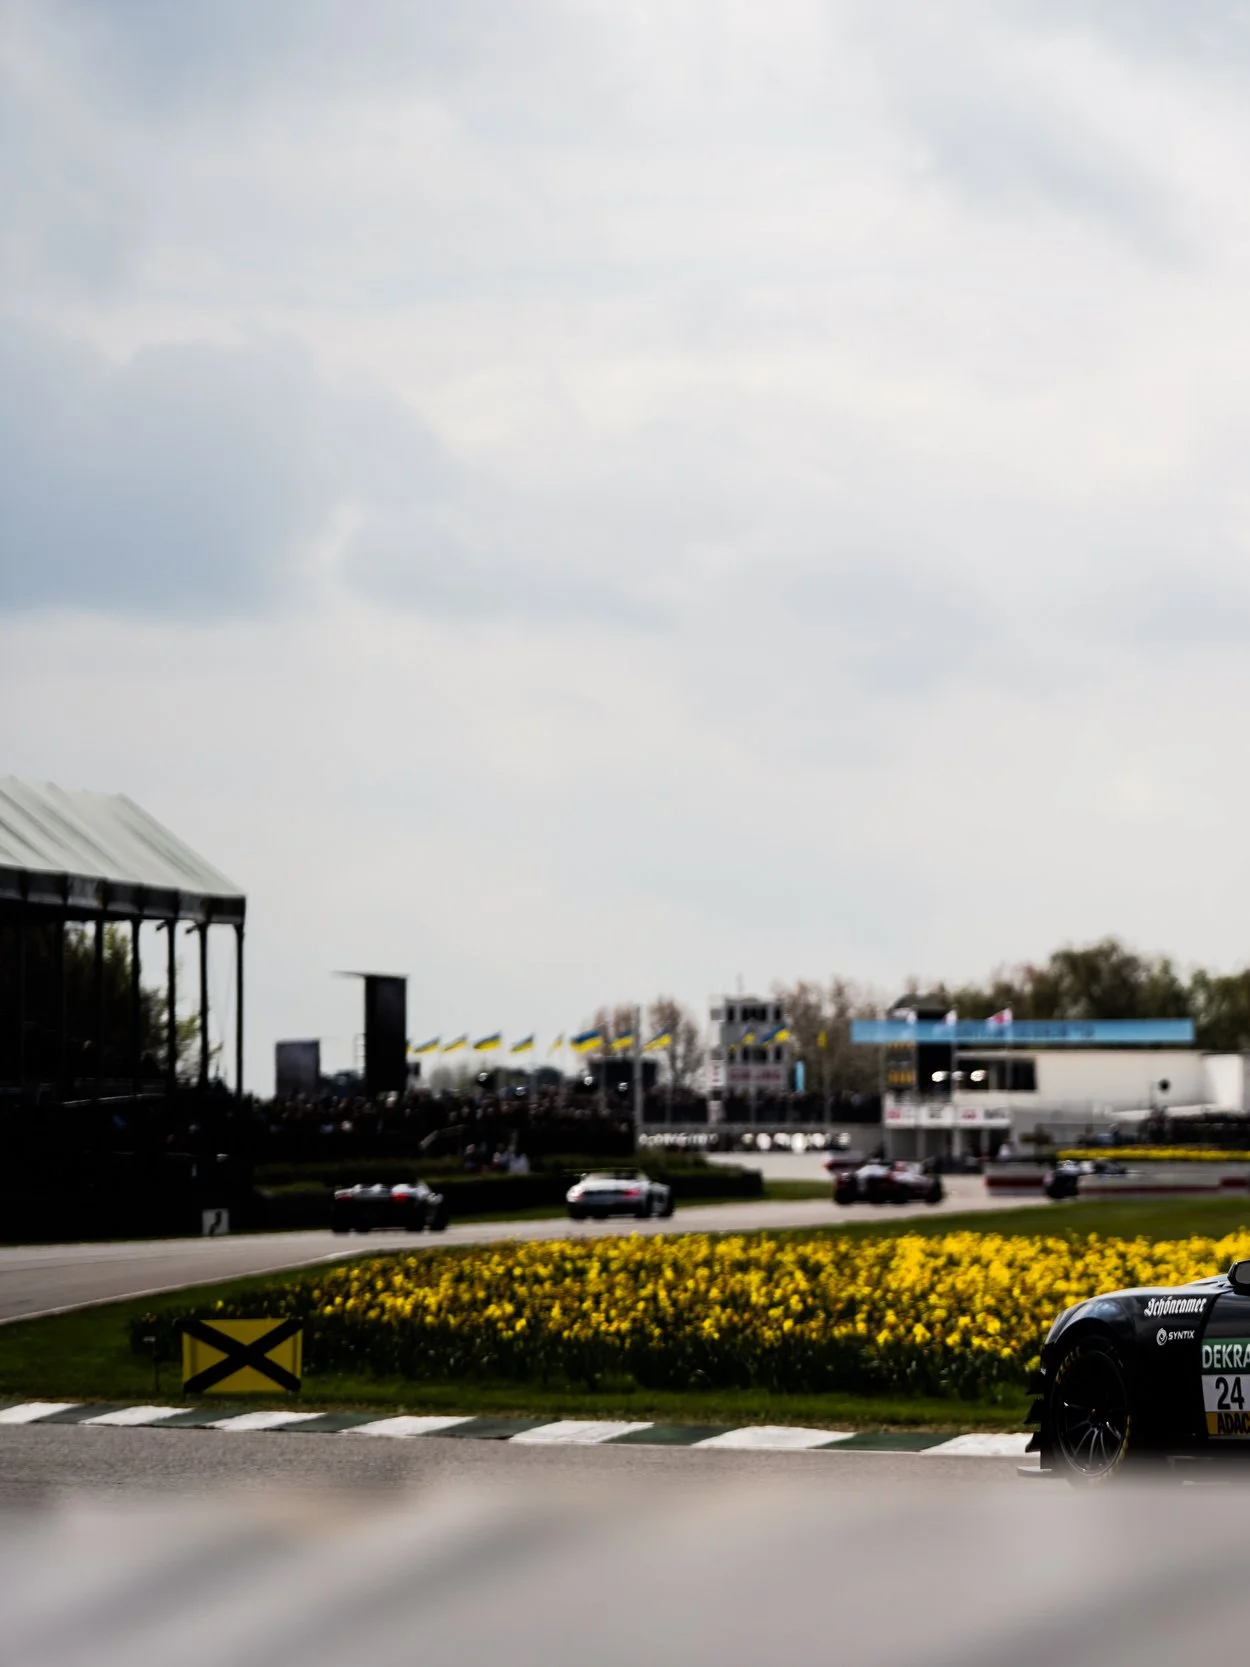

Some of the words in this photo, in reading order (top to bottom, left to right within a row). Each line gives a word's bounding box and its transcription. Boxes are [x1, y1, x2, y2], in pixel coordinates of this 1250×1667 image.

[1144, 1296, 1208, 1318] Schönramer
[1168, 1329, 1195, 1341] SYNTIX
[1215, 1376, 1245, 1410] 24
